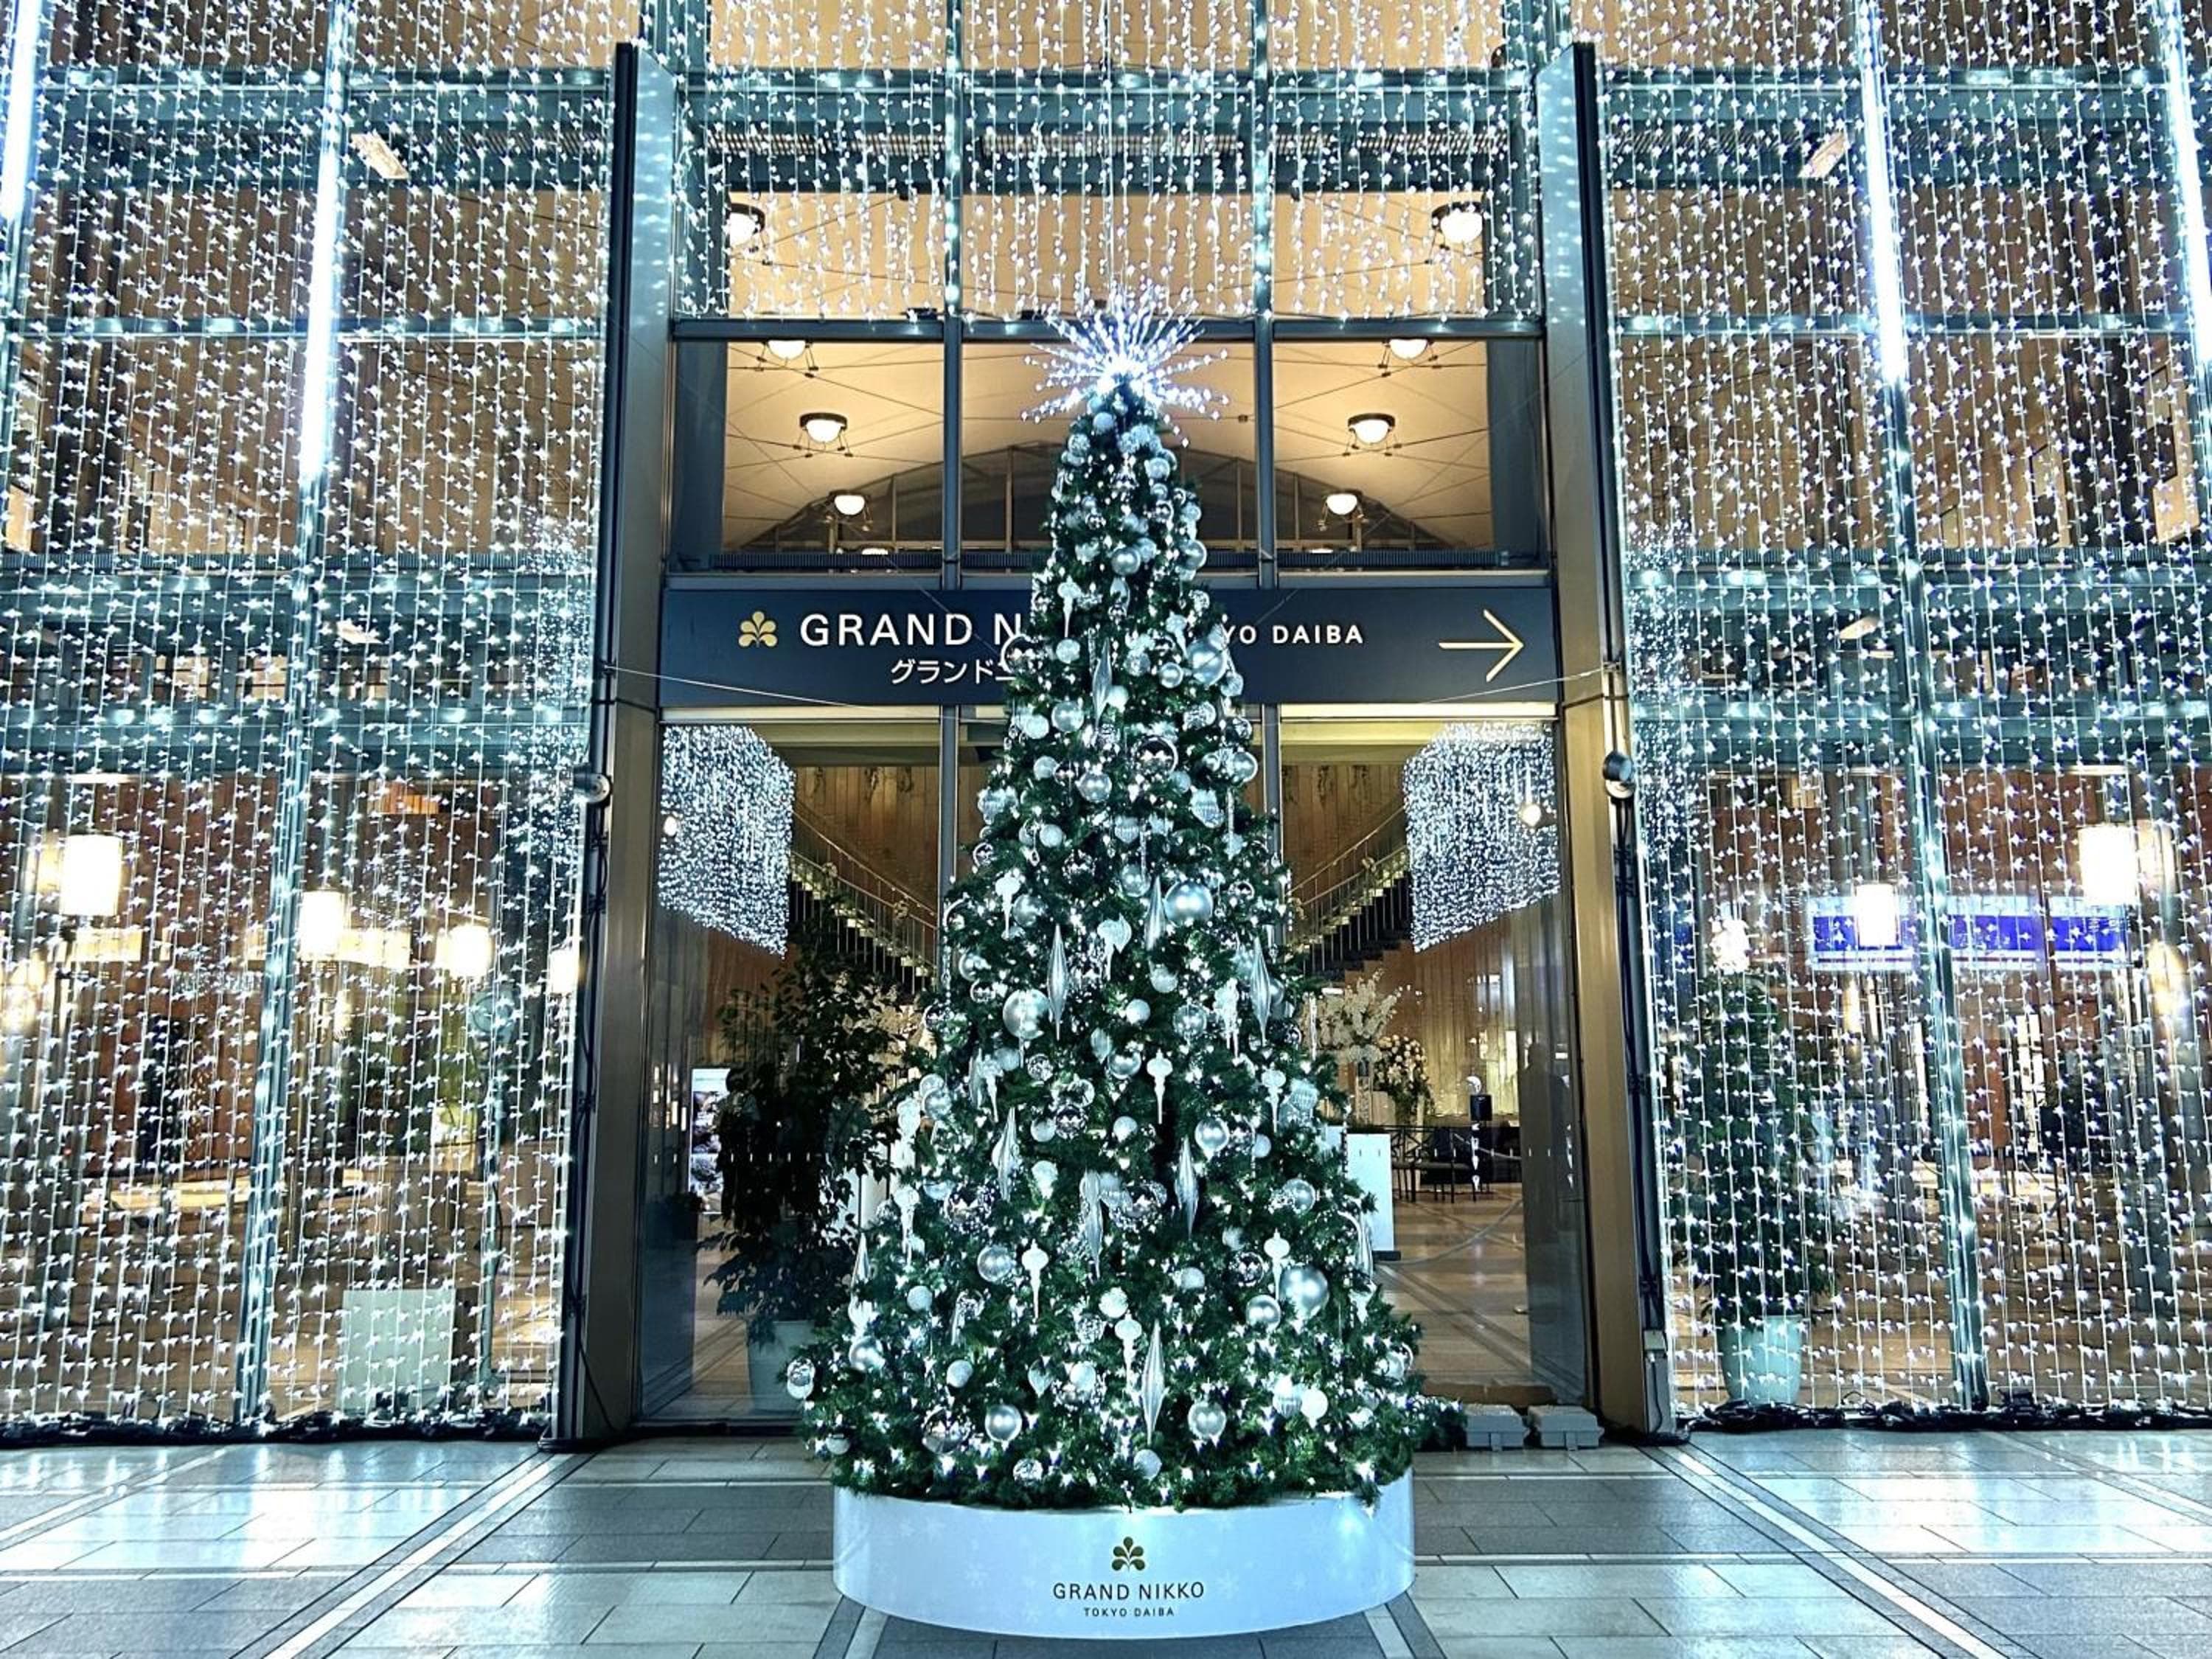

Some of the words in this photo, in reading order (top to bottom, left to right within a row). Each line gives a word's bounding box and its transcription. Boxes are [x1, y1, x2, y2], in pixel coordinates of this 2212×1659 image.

[800, 613, 973, 646] GRAND
[1272, 625, 1363, 644] DAIBA
[1052, 1582, 1130, 1601] GRAND
[1138, 1581, 1204, 1601] NIKKO
[1083, 1607, 1127, 1618] TOKYO
[1133, 1607, 1175, 1618] DAIBA
